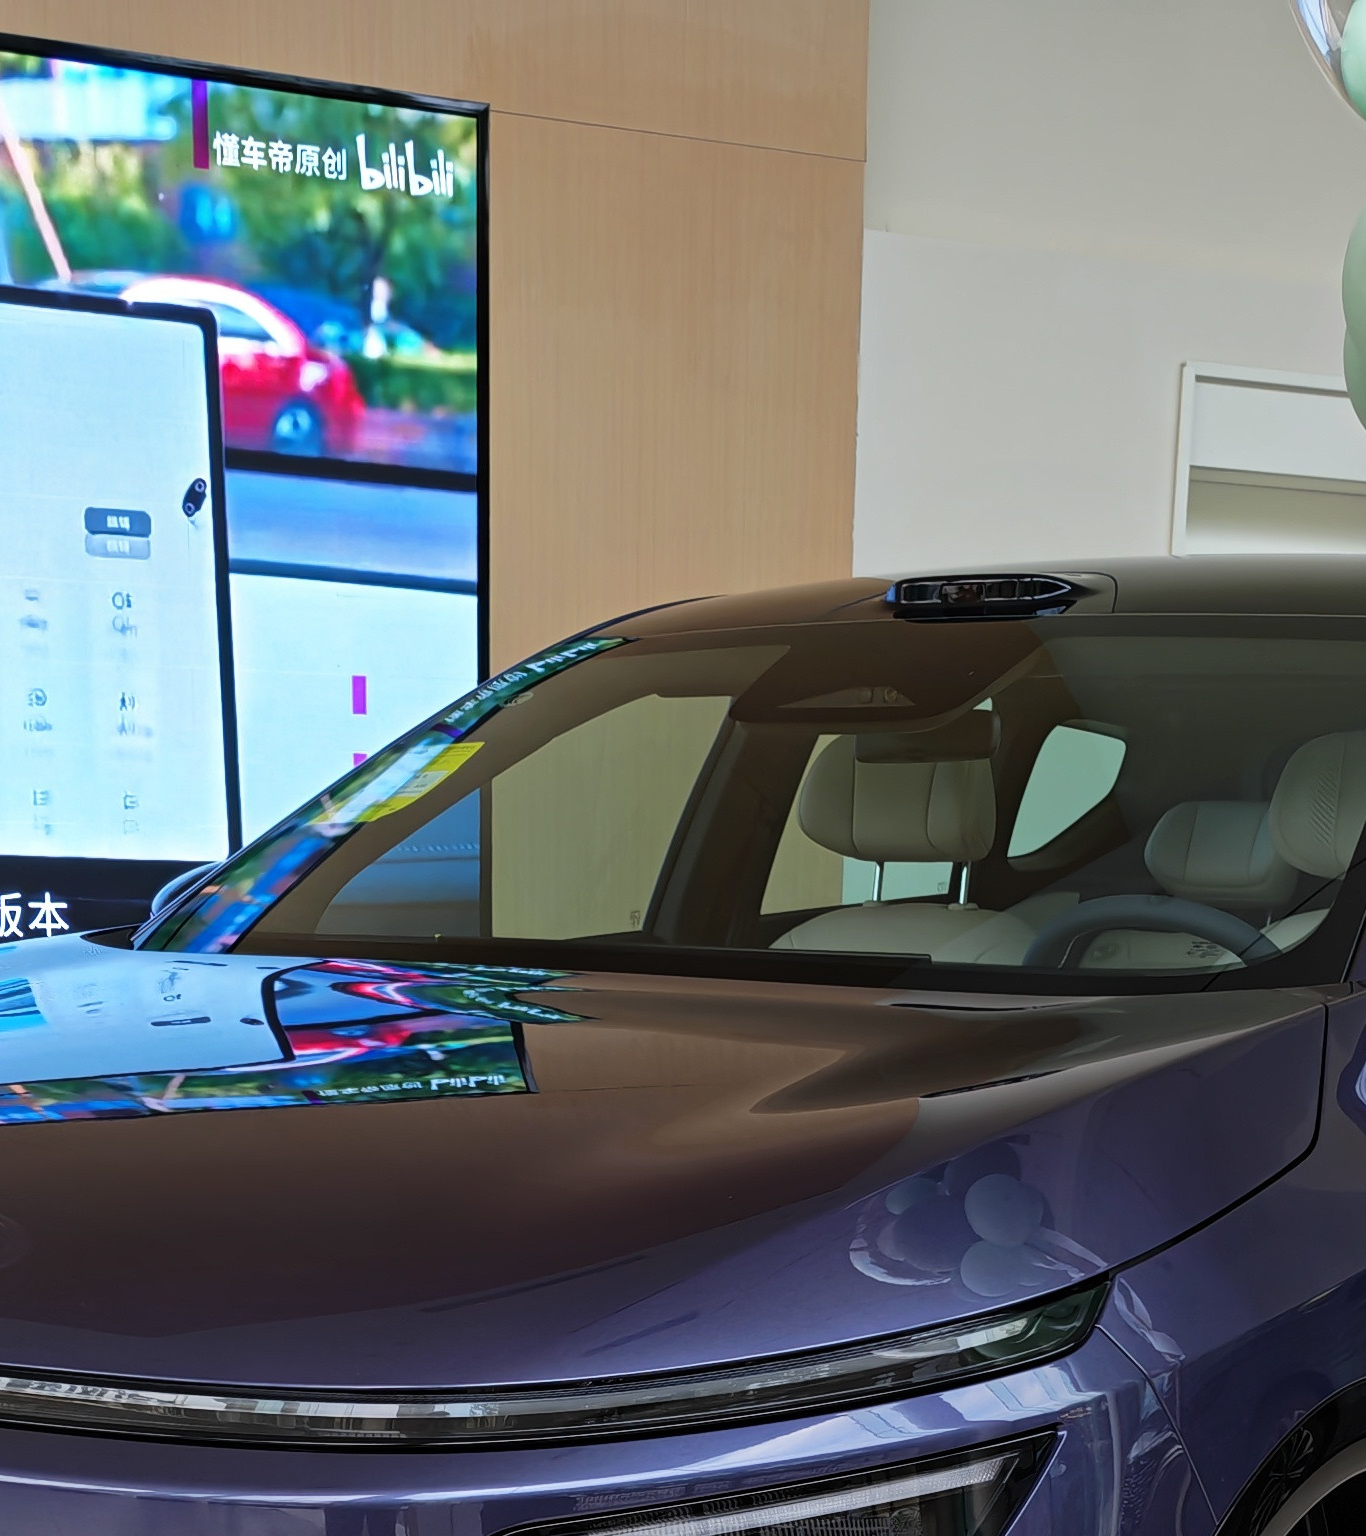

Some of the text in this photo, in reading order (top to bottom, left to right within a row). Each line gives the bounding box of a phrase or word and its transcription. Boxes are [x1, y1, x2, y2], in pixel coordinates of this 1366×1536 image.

[212, 130, 454, 198] 懂车帝原创 bilibili
